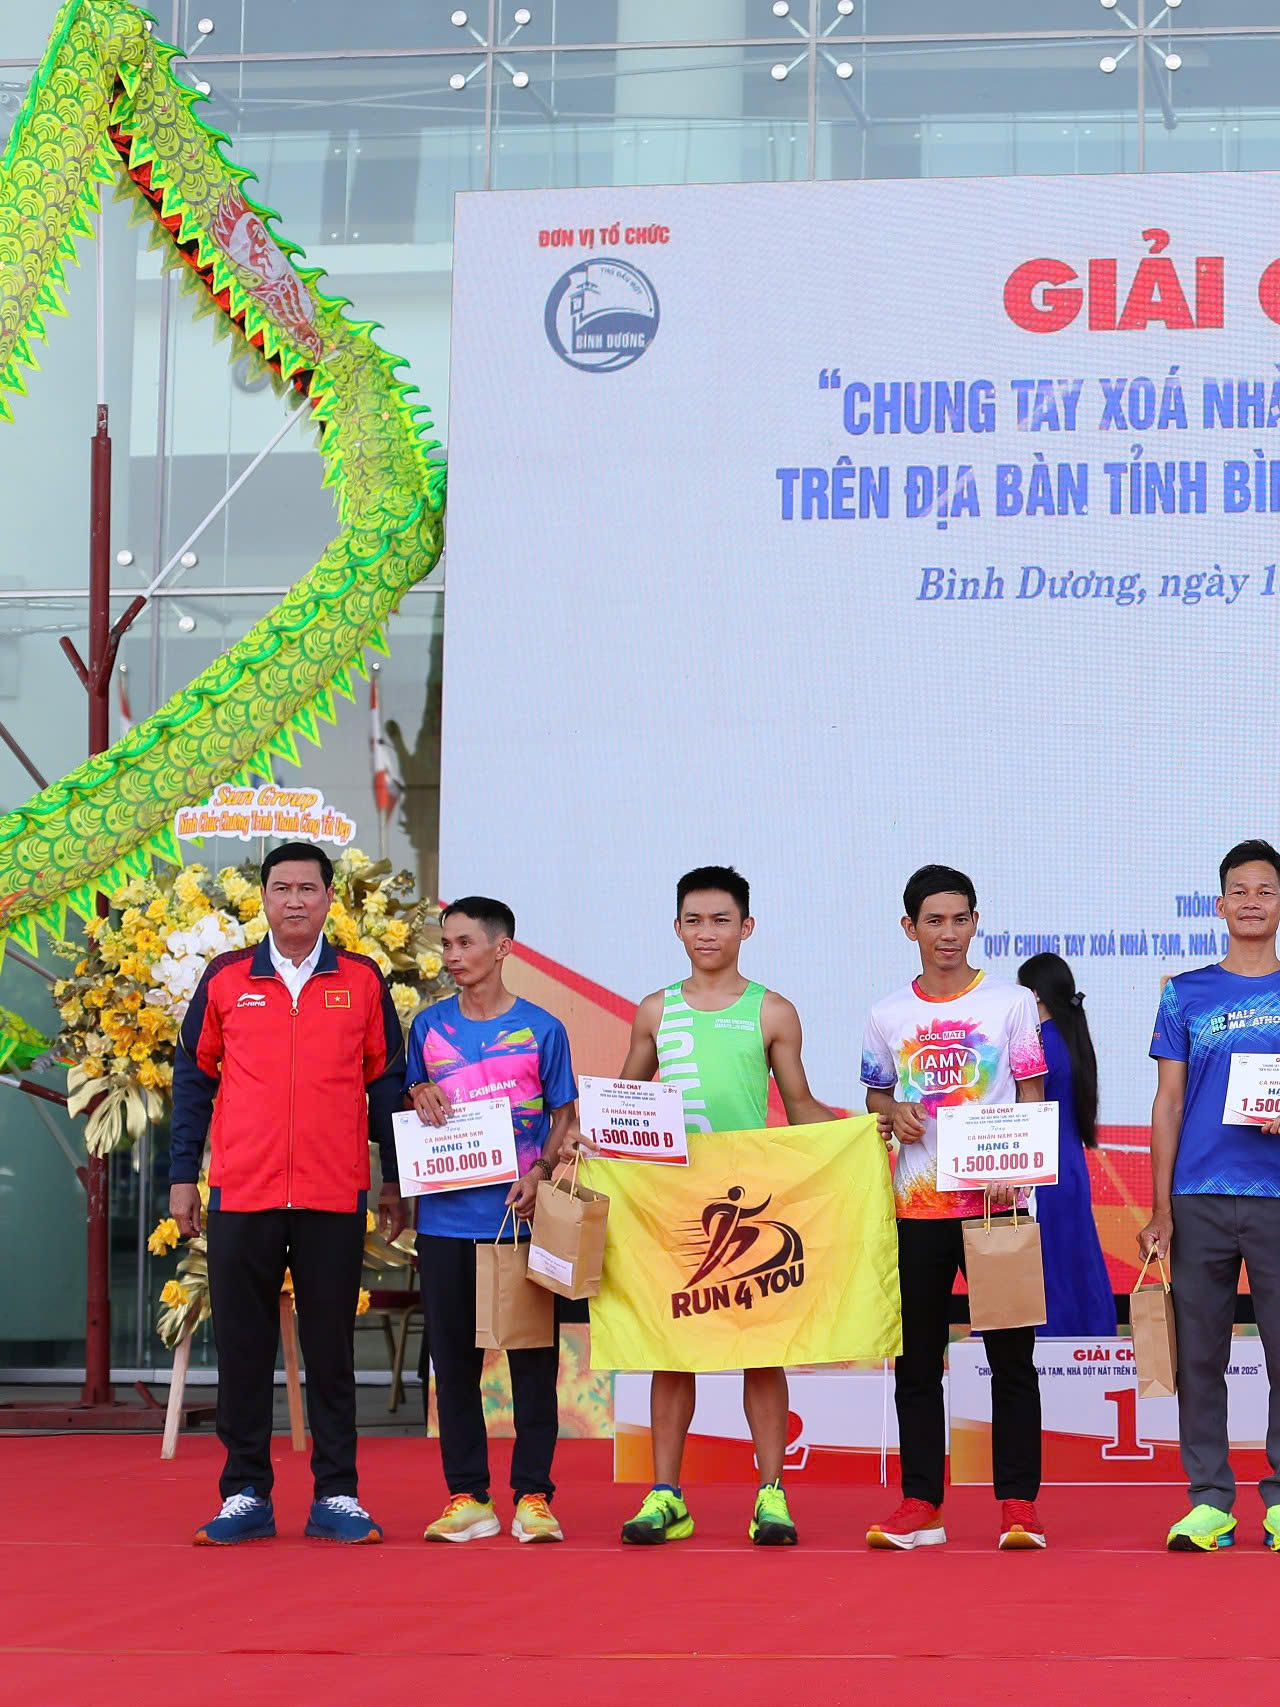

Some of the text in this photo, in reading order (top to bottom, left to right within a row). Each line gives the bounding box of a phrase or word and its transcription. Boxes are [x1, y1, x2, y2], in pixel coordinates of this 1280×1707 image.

[538, 222, 670, 249] ĐƠN VỊ TỔ CHỨC
[1003, 228, 1224, 333] GIẢI
[576, 331, 646, 350] BÌNH DƯƠNG
[818, 368, 996, 436] “CHUNG
[1011, 378, 1084, 432] TAY
[1099, 366, 1188, 431] XOÁ
[776, 456, 890, 521] TRÊN
[904, 464, 981, 530] ĐỊA
[996, 452, 1089, 516] BÀN
[1104, 443, 1206, 515] TỈNH
[916, 564, 1004, 602] Bình
[1016, 564, 1146, 605] Dương,
[1160, 565, 1249, 604] ngày
[214, 786, 318, 812] Sun Group
[1014, 933, 1060, 957] CHUNG
[1064, 934, 1086, 956] TAY
[1089, 929, 1116, 956] XOÁ
[1120, 928, 1148, 956] NHÀ
[1152, 932, 1185, 960] TẠM,
[1189, 928, 1220, 956] NHÀ
[236, 1000, 266, 1008] LI-NING
[920, 1052, 968, 1070] IAMV
[924, 1070, 962, 1086] RUN
[610, 1118, 650, 1128] HẠNG 9
[432, 1140, 480, 1154] HẠNG 10
[590, 1128, 674, 1148] 1.500.000 Đ
[978, 1142, 1009, 1152] HẠNG
[412, 1149, 502, 1177] 1.500.000 Đ
[952, 1152, 1044, 1174] 1.500.000 Đ
[672, 1262, 805, 1319] RUN 4 YOU
[1073, 1345, 1110, 1362] GIẢI
[1049, 1366, 1065, 1378] TẠM,
[1066, 1364, 1081, 1376] NHÀ
[1082, 1364, 1096, 1378] DỘT
[1098, 1364, 1111, 1376] NÁT
[1112, 1364, 1129, 1376] TRÊN
[1102, 1388, 1154, 1460] 1
